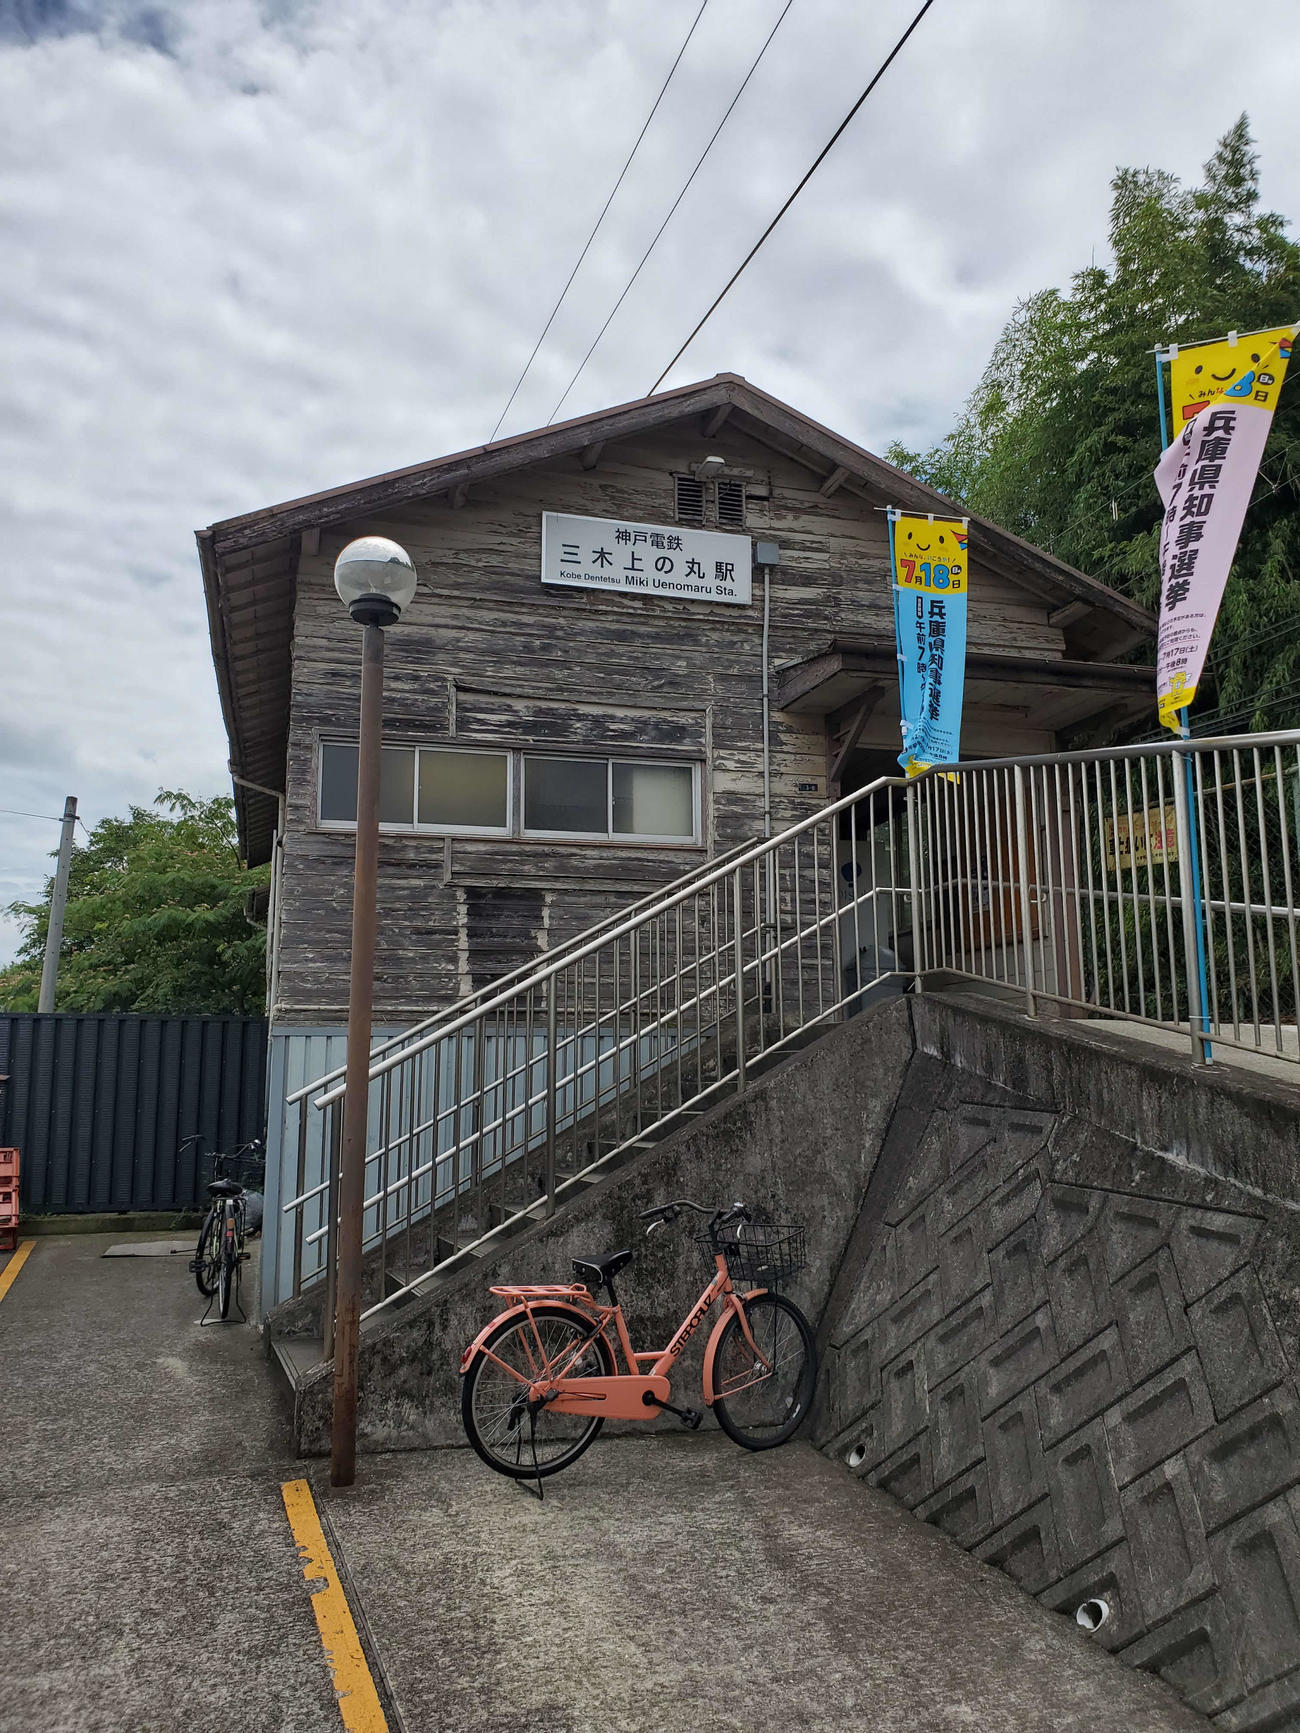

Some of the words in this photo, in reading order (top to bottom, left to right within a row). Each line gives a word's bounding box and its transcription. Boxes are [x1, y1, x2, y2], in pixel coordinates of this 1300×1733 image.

[1166, 410, 1237, 613] 兵庫県知事選挙
[614, 528, 683, 551] 神戸電鉄
[560, 543, 735, 582] 三木上の丸駅
[560, 570, 582, 580] Kobe
[584, 573, 621, 584] Dentetsu
[625, 575, 649, 587] Miki
[652, 578, 712, 594] Uenomaru
[715, 585, 737, 597] Sta.
